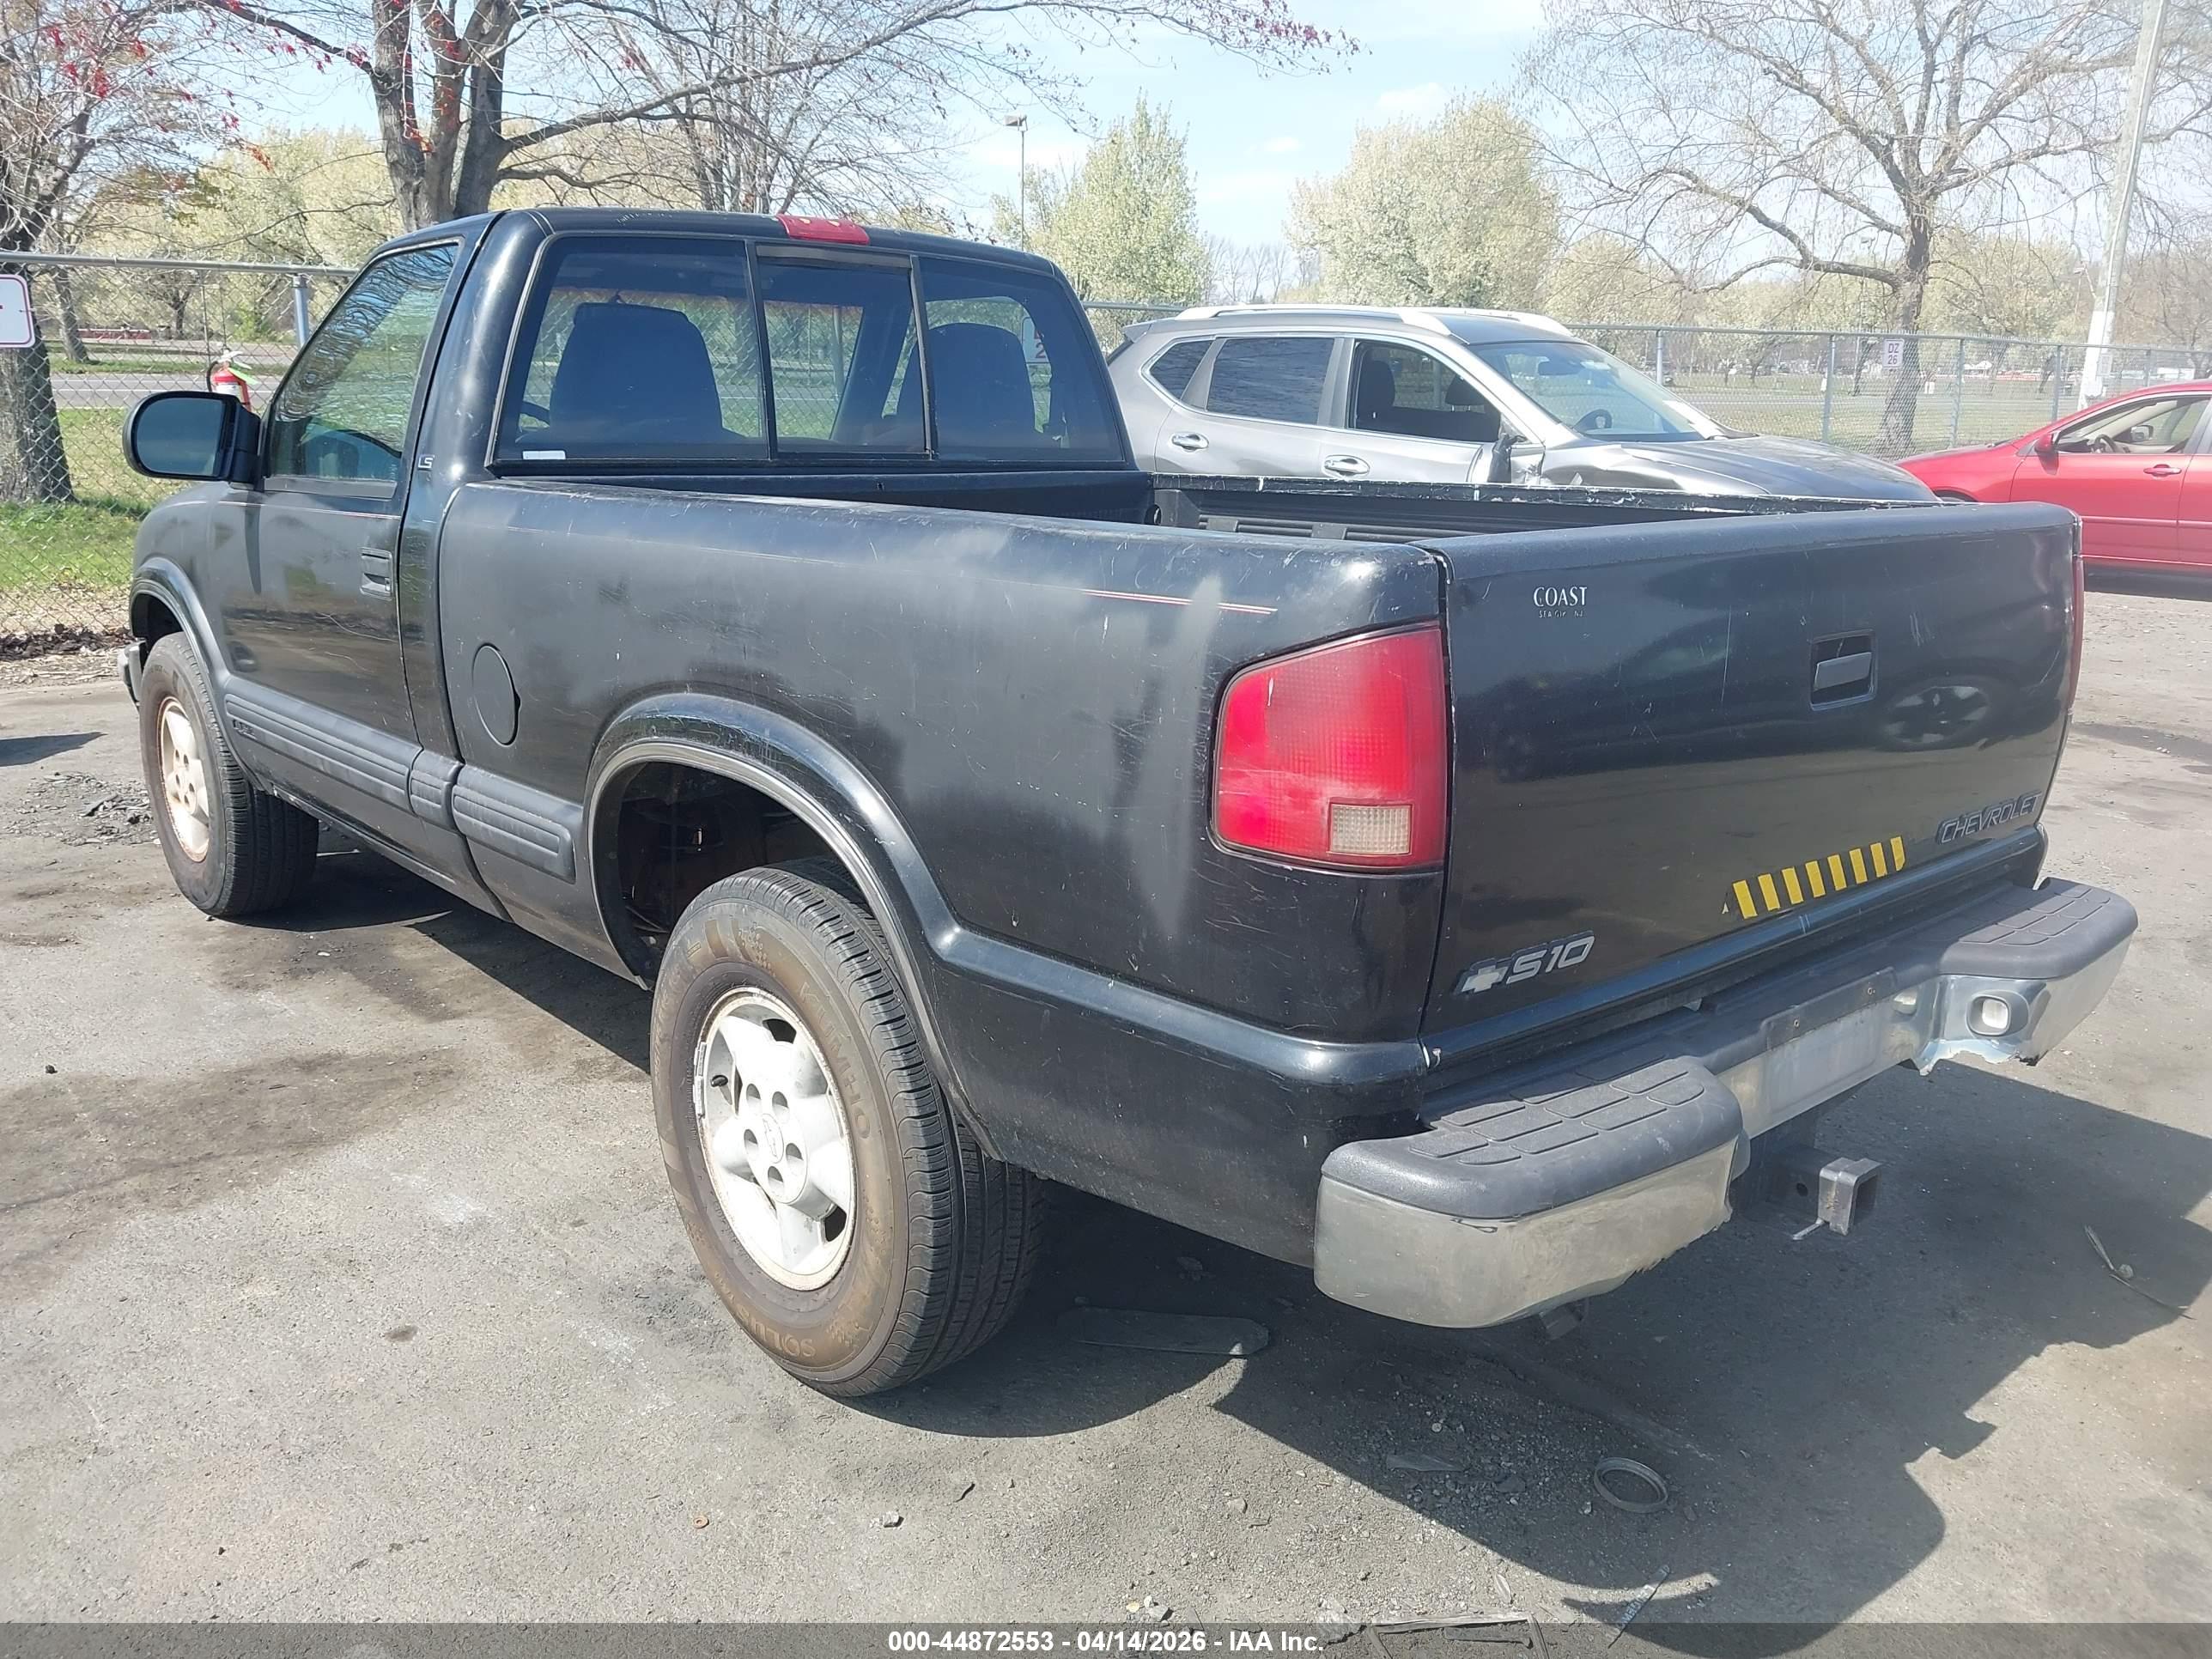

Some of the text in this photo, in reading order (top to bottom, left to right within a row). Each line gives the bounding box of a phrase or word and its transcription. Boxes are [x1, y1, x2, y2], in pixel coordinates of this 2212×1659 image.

[1889, 343, 1899, 353] DZ
[1888, 355, 1898, 364] 26
[418, 457, 434, 469] LS
[1533, 586, 1587, 606] COAST
[1942, 792, 2042, 843] CHEVROLET
[1506, 936, 1595, 984] S10
[799, 981, 871, 1139] KUMHO
